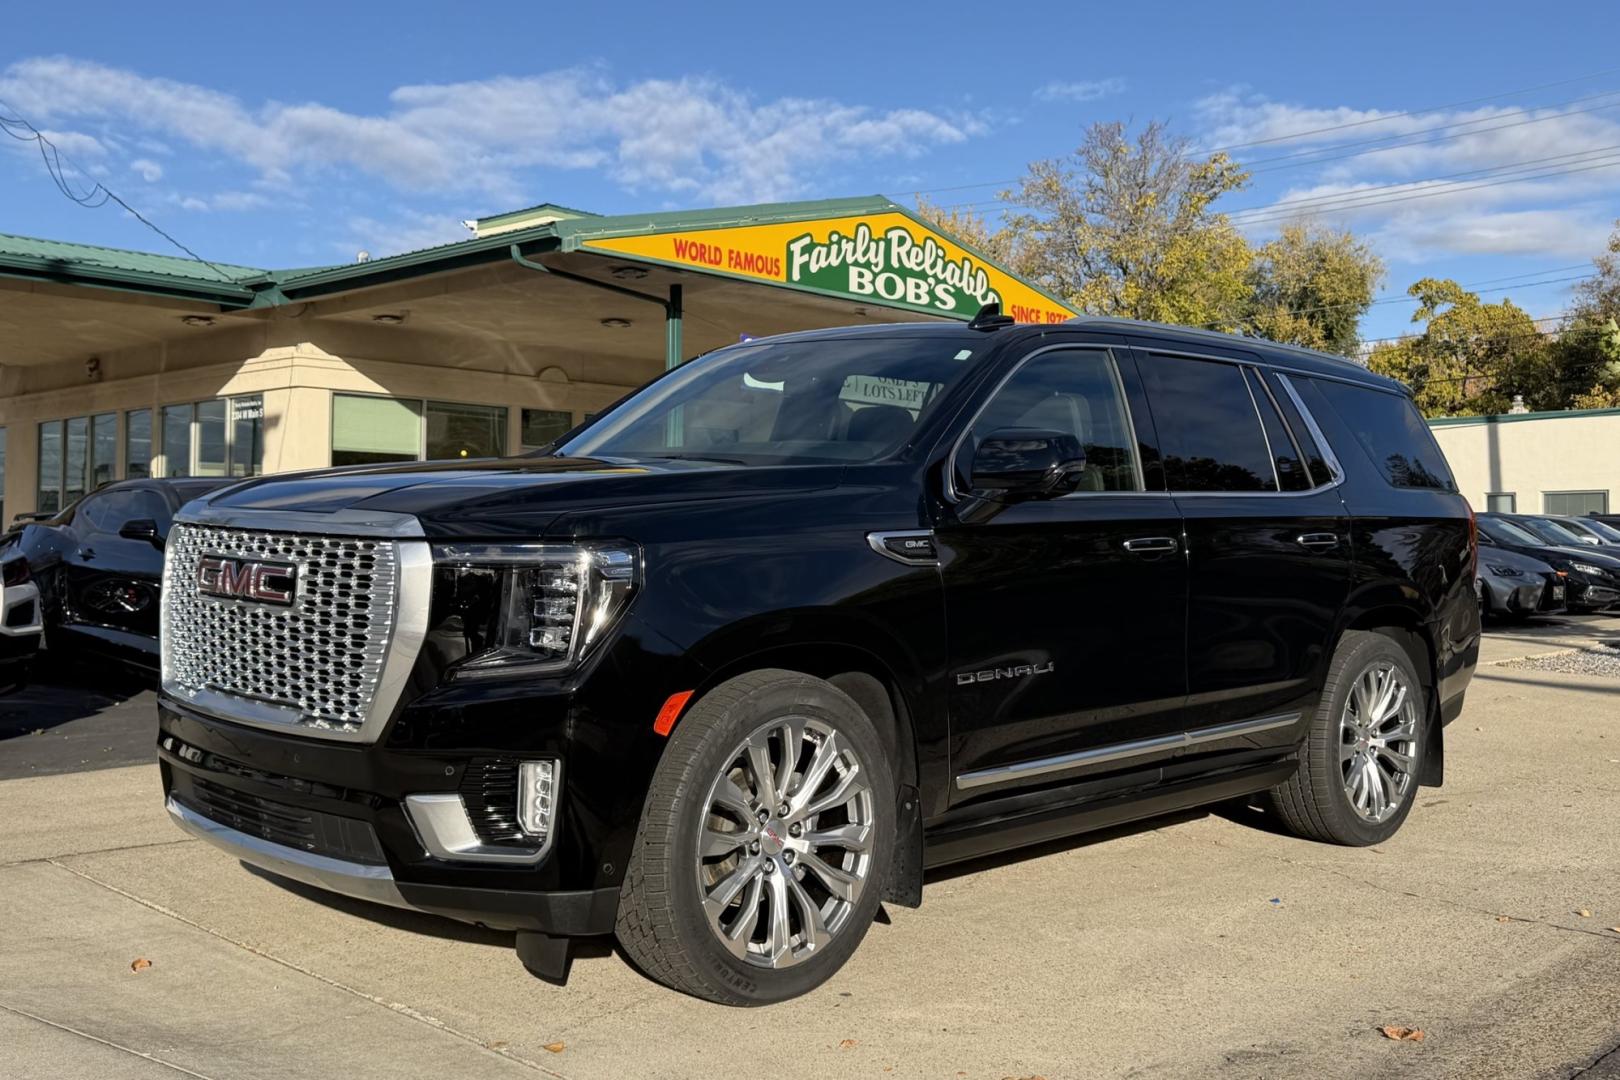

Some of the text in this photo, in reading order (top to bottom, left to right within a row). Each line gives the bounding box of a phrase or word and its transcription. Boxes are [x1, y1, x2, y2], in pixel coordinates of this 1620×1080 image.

[673, 238, 781, 277] WORLD FAMOUS
[790, 225, 884, 281] Fairly
[848, 267, 957, 310] BOB'S
[1011, 304, 1041, 324] SINCE
[863, 383, 896, 400] LOTS
[905, 540, 929, 548] GMC
[197, 560, 293, 602] GMC
[957, 661, 1055, 685] DENALI
